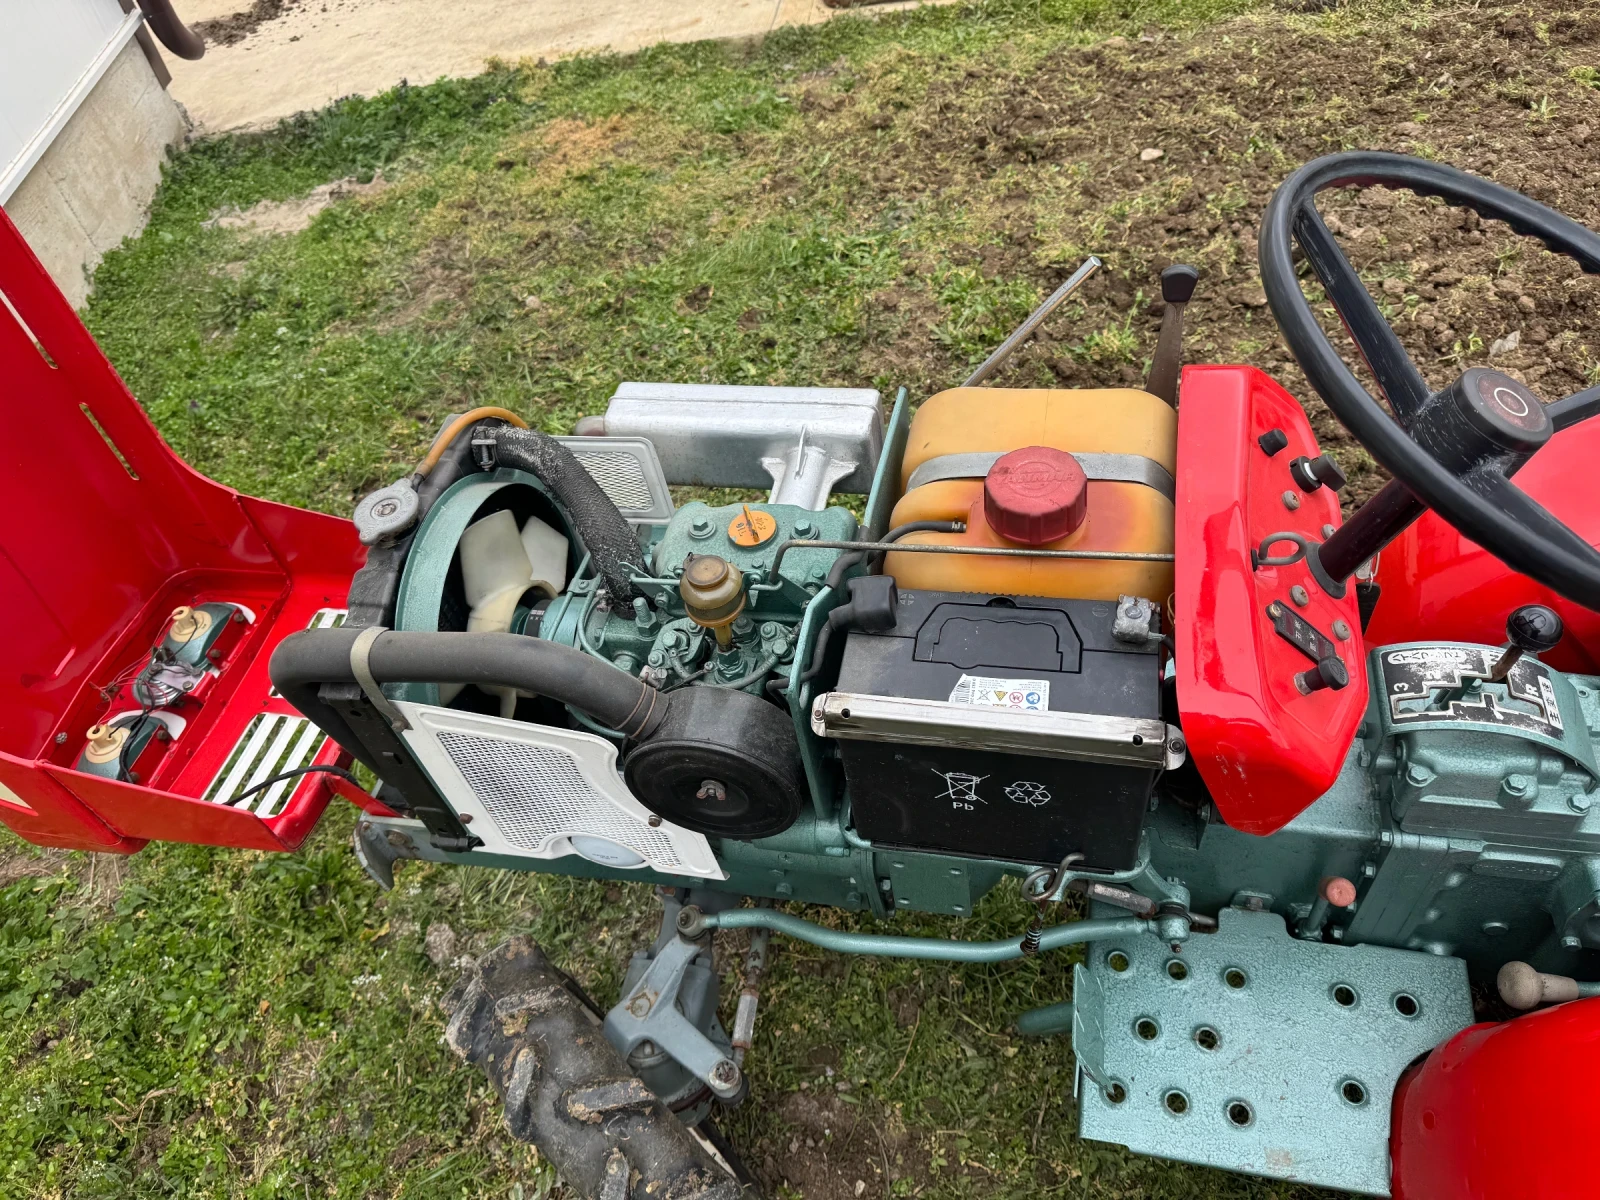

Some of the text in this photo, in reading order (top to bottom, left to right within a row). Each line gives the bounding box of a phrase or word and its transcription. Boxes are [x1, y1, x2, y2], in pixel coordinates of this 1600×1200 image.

[1393, 682, 1410, 692] 3
[1525, 684, 1539, 696] R
[952, 801, 974, 811] Pb
